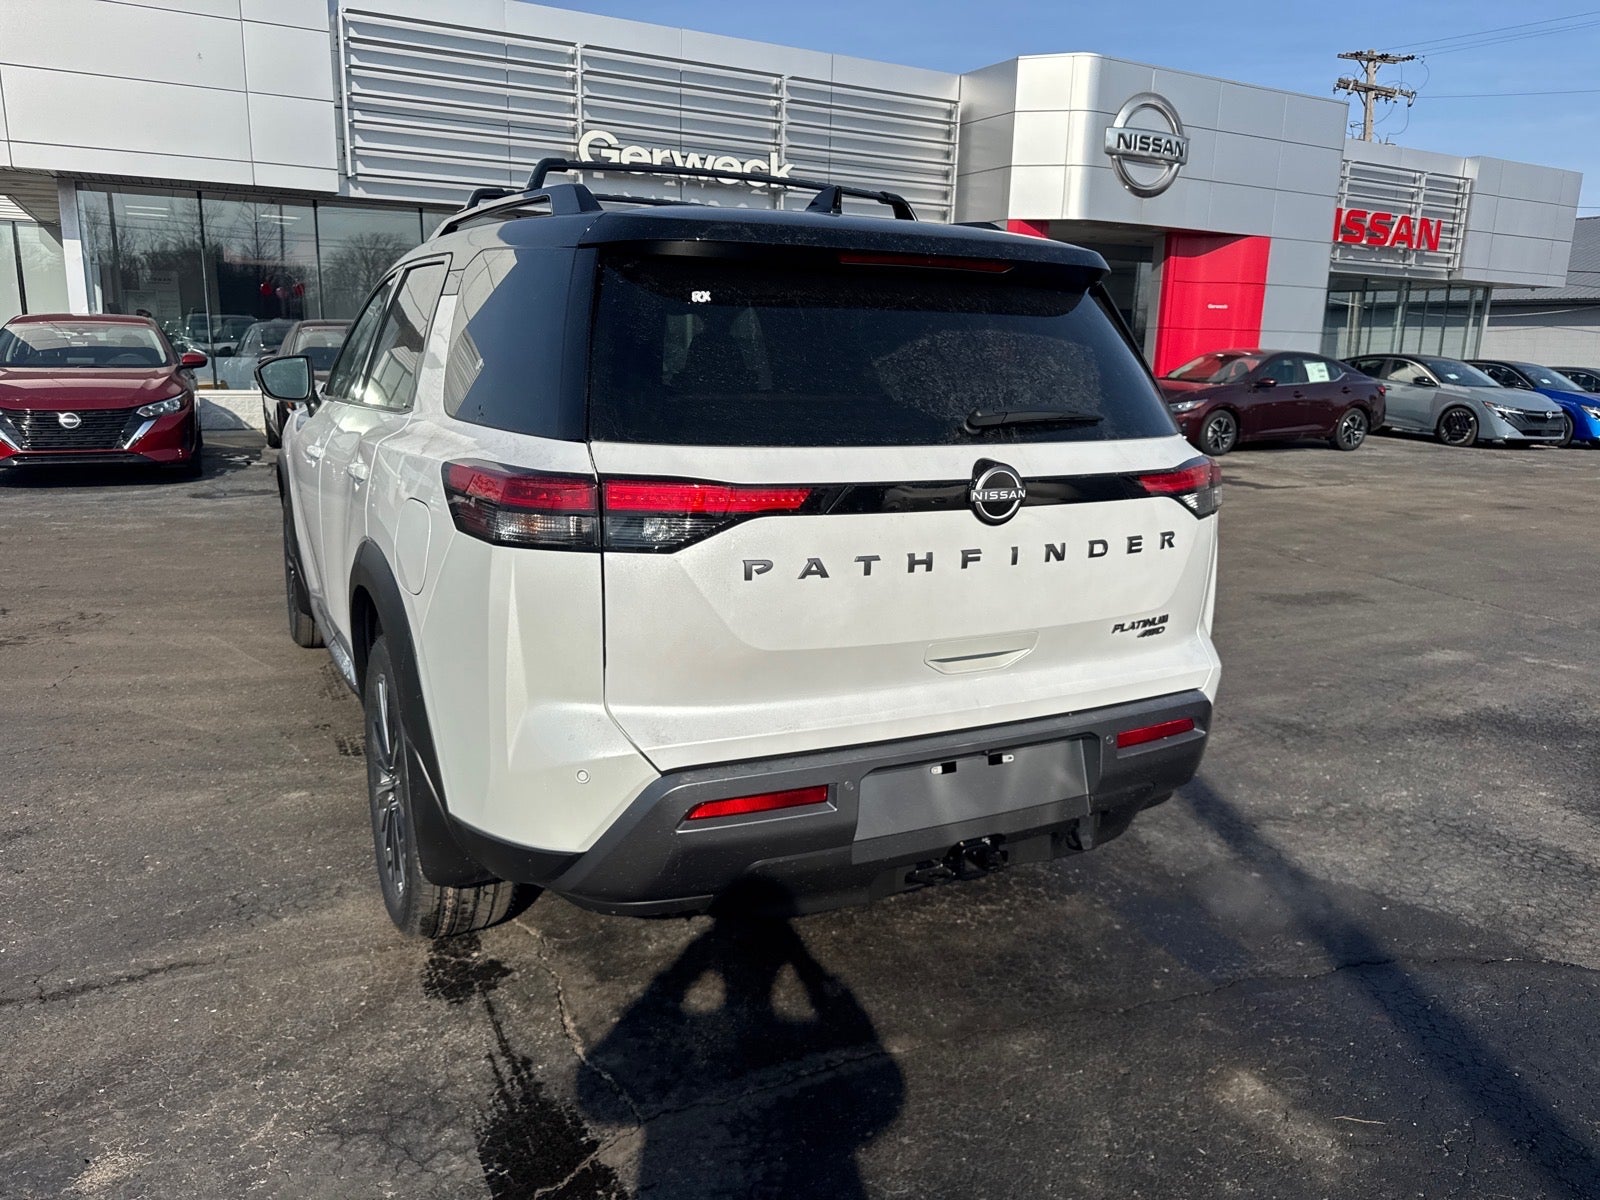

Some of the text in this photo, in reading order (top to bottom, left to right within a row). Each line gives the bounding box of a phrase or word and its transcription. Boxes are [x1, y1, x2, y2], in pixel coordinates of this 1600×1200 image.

[1116, 132, 1185, 157] NISSAN
[578, 129, 798, 189] Gerweck
[972, 489, 1026, 500] NISSAN
[742, 530, 1176, 582] PATHFINDER
[1111, 613, 1169, 634] PLATINUM
